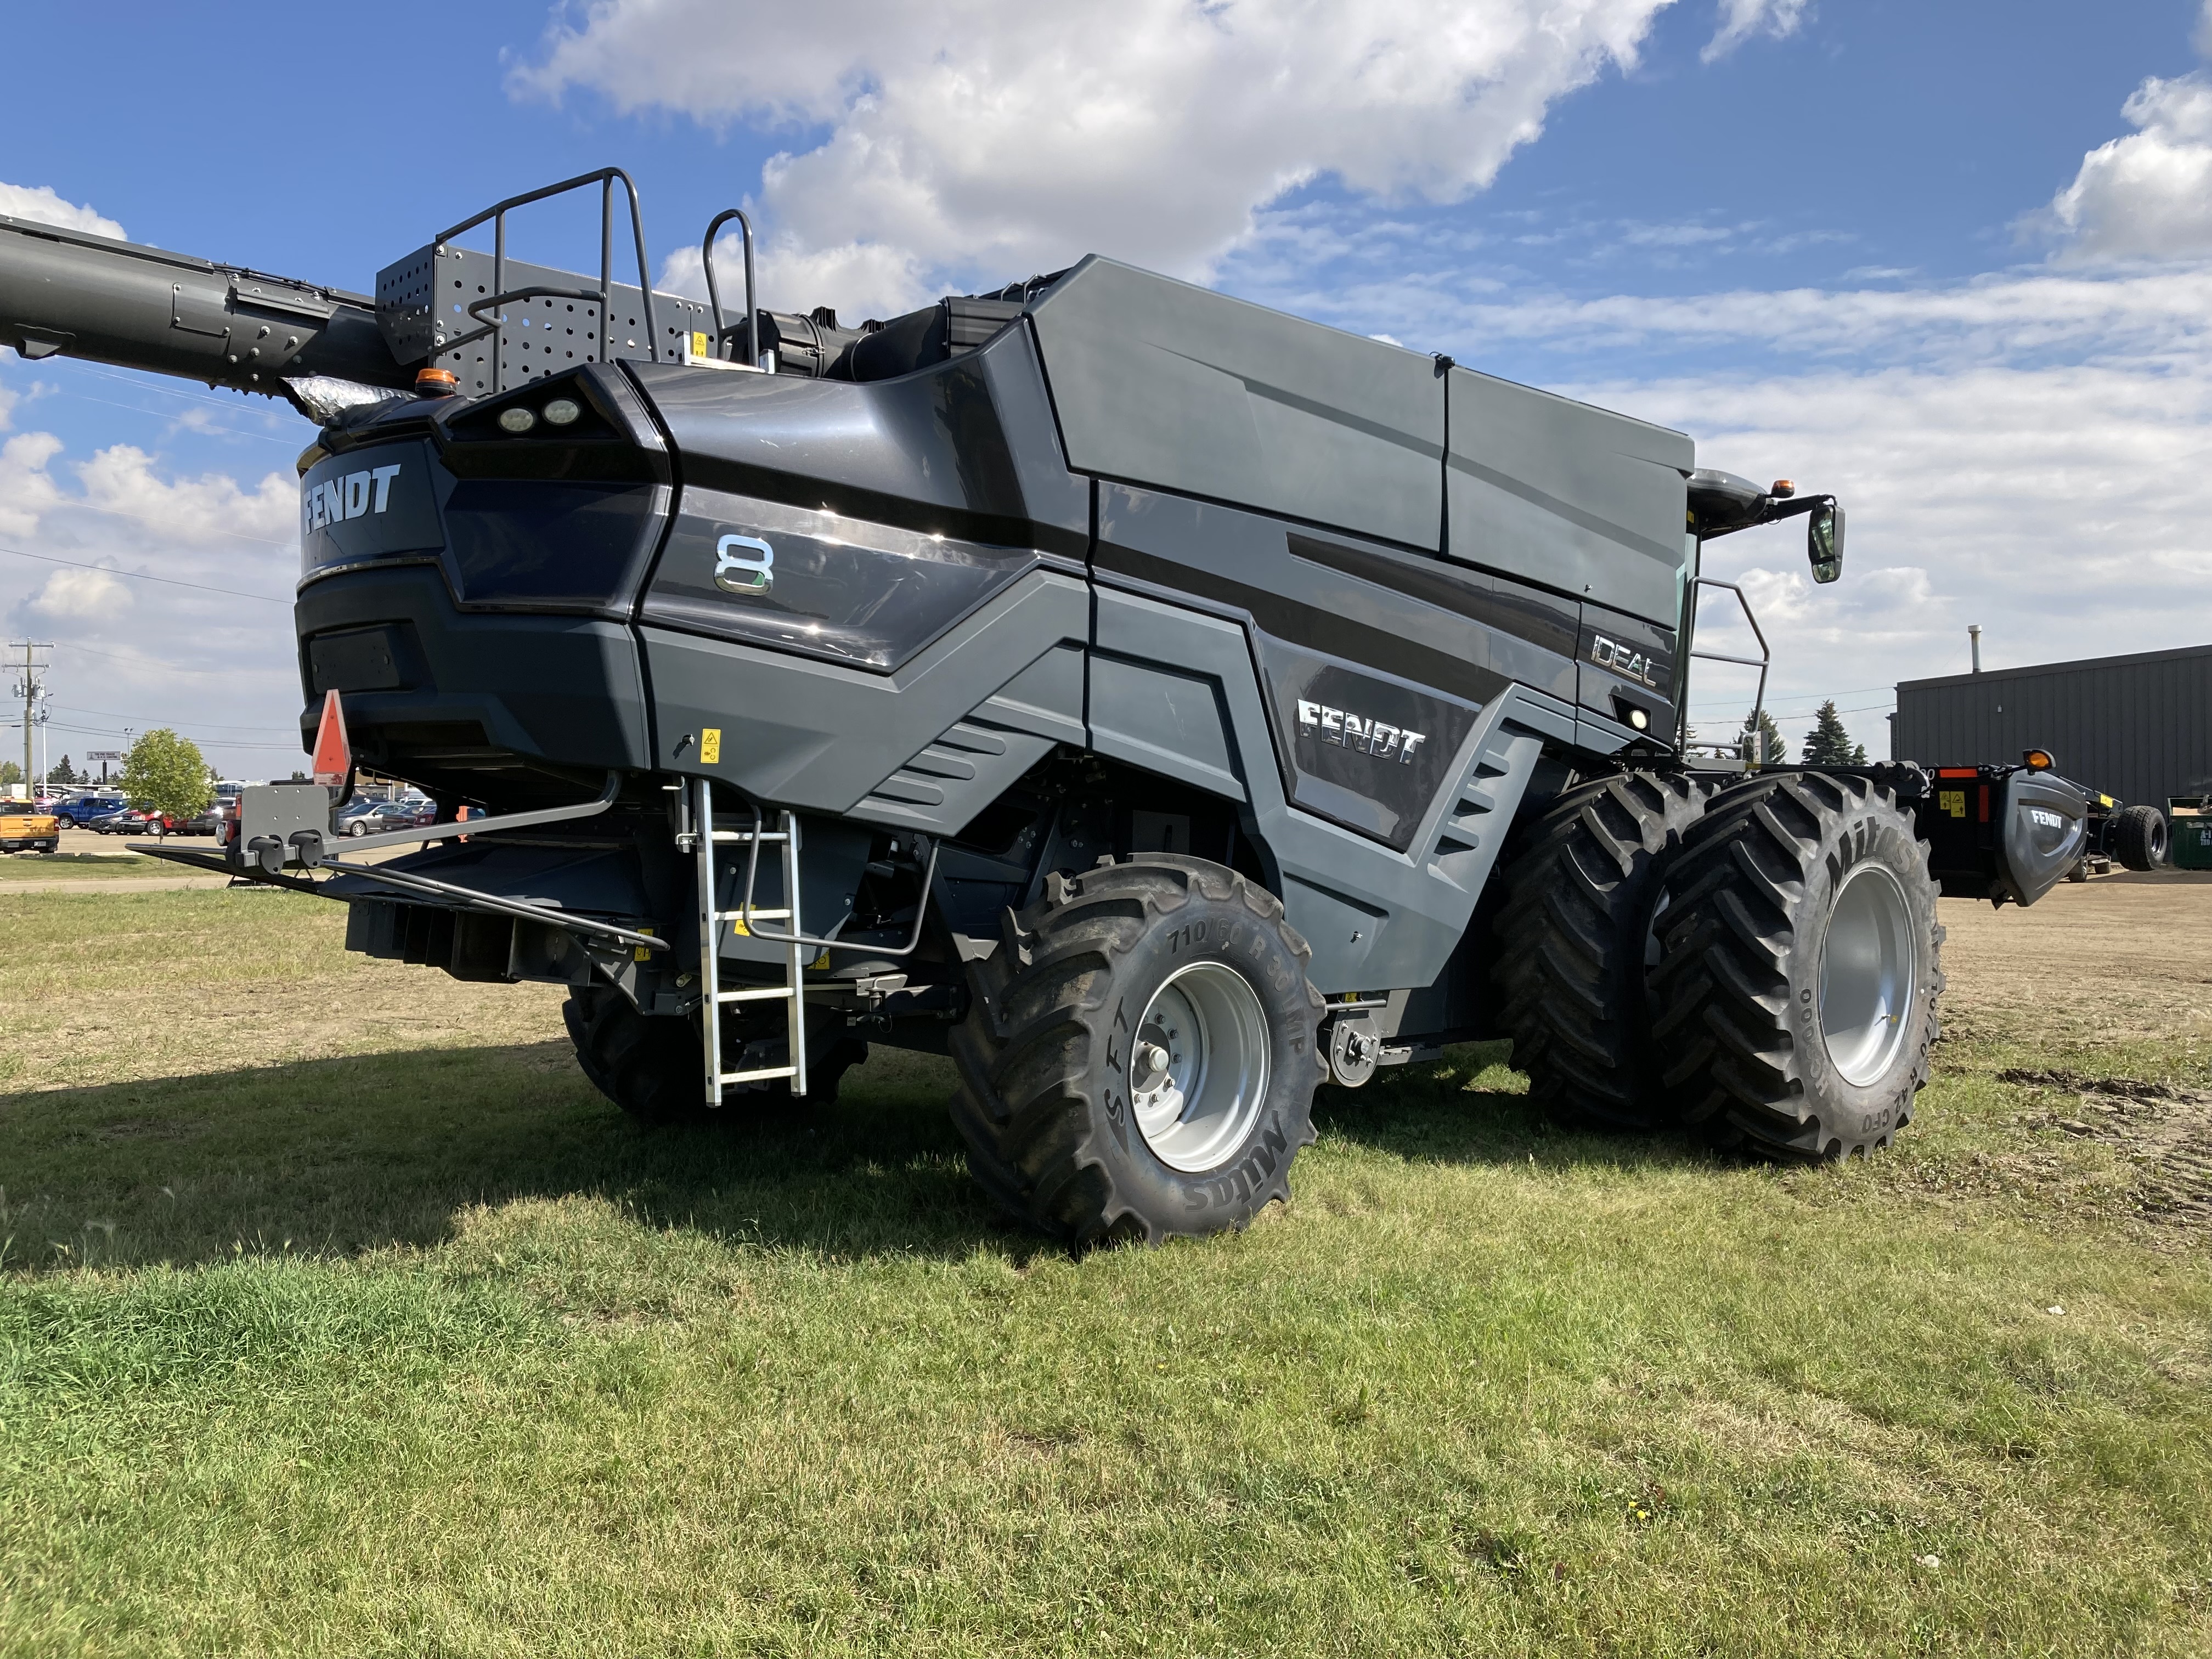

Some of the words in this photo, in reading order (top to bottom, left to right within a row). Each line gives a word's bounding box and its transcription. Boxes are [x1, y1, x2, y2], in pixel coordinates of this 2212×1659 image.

[303, 464, 401, 535] FENDT
[714, 534, 774, 597] 8
[1591, 635, 1656, 687] IDEAL
[1297, 699, 1426, 766] FENDT
[2031, 810, 2062, 829] FENDT
[1825, 816, 1916, 913] Mitas
[1166, 917, 1243, 955] 710/60
[1248, 934, 1267, 961] R
[1266, 955, 1290, 992] 30
[1184, 1109, 1288, 1212] Mitas
